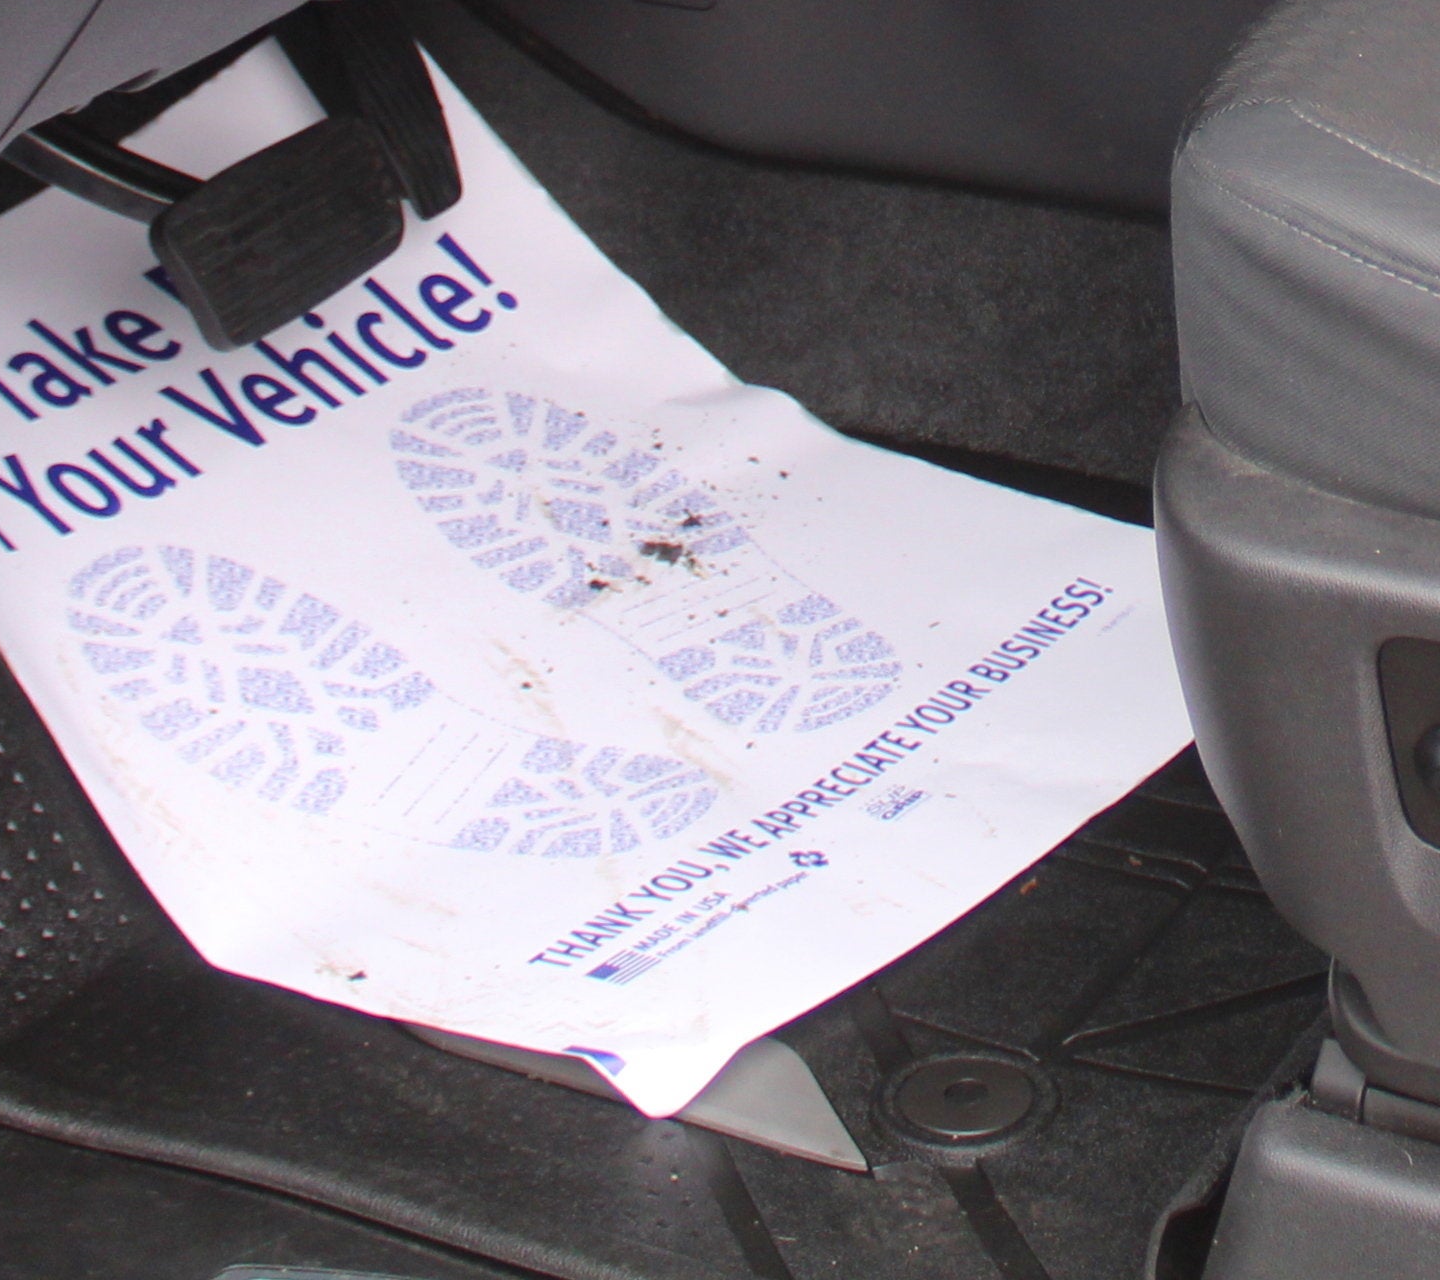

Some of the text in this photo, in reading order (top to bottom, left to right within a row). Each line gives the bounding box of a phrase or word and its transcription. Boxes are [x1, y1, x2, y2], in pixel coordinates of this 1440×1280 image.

[158, 232, 519, 448] Vehicle!
[528, 902, 656, 968] THANK
[627, 860, 731, 902] YOU,
[698, 829, 770, 860] WE
[751, 730, 923, 839] APPRECIATE
[894, 680, 992, 734] YOUR
[967, 577, 1115, 683] BUSINESS!
[633, 892, 732, 952] MADE IN USA
